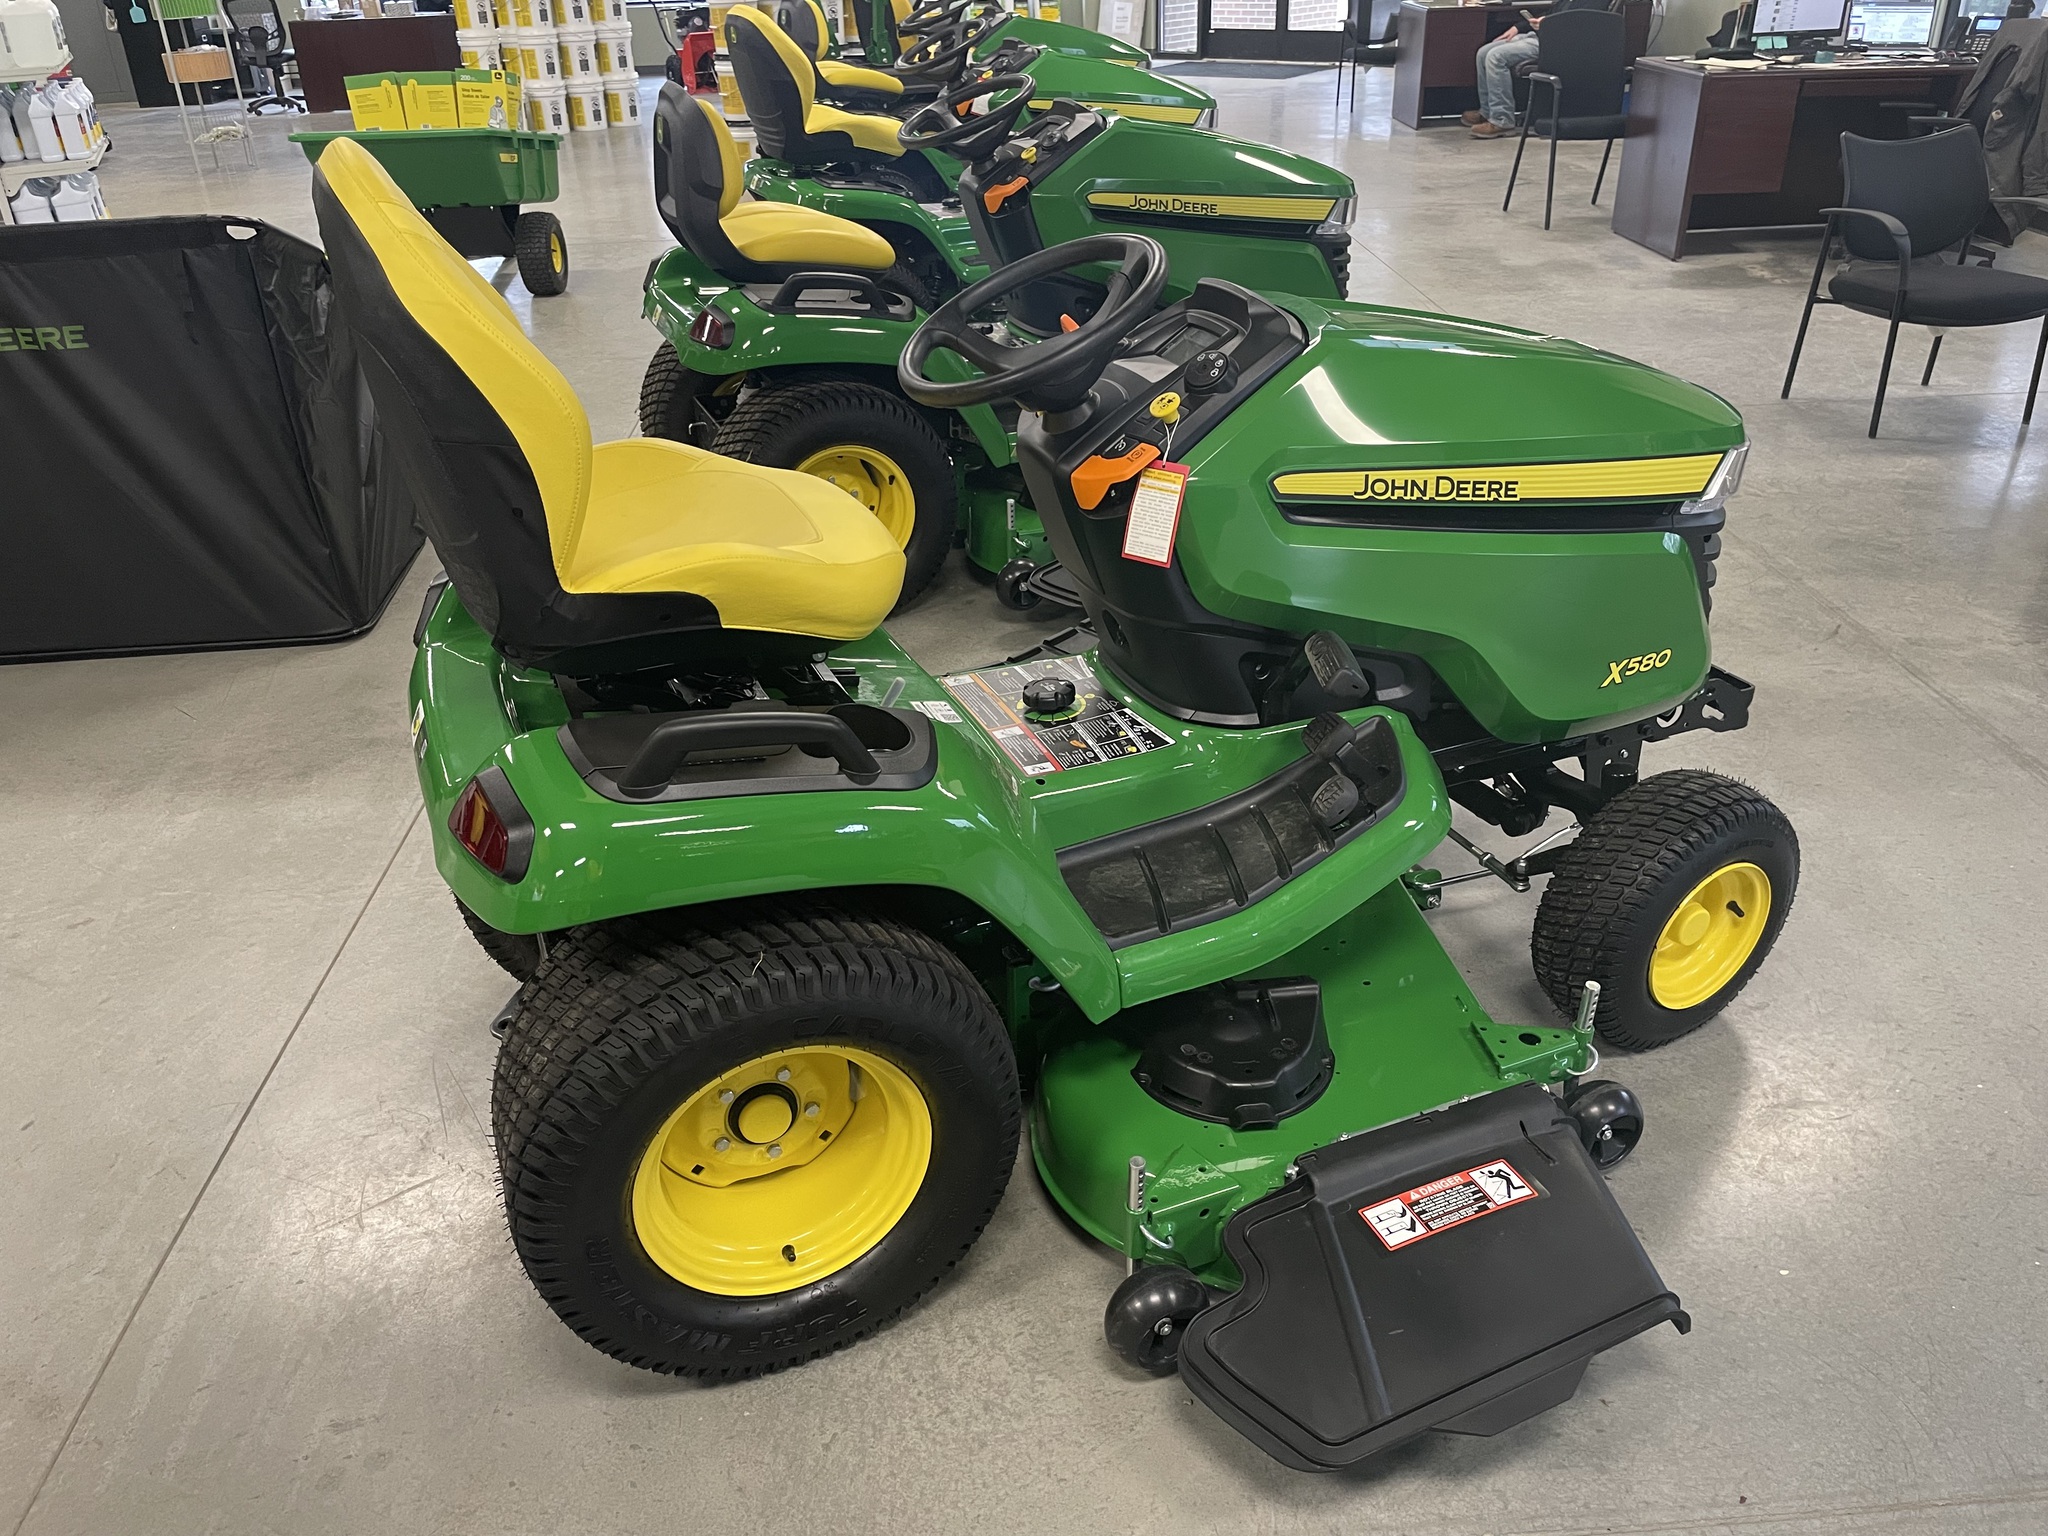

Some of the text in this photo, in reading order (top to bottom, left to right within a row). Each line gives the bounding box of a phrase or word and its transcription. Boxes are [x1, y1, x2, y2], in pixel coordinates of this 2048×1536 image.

[1129, 195, 1219, 215] JOHN DEERE
[1353, 474, 1520, 500] JOHN DEERE
[1598, 648, 1673, 689] X580
[1418, 1175, 1463, 1196] DANGER
